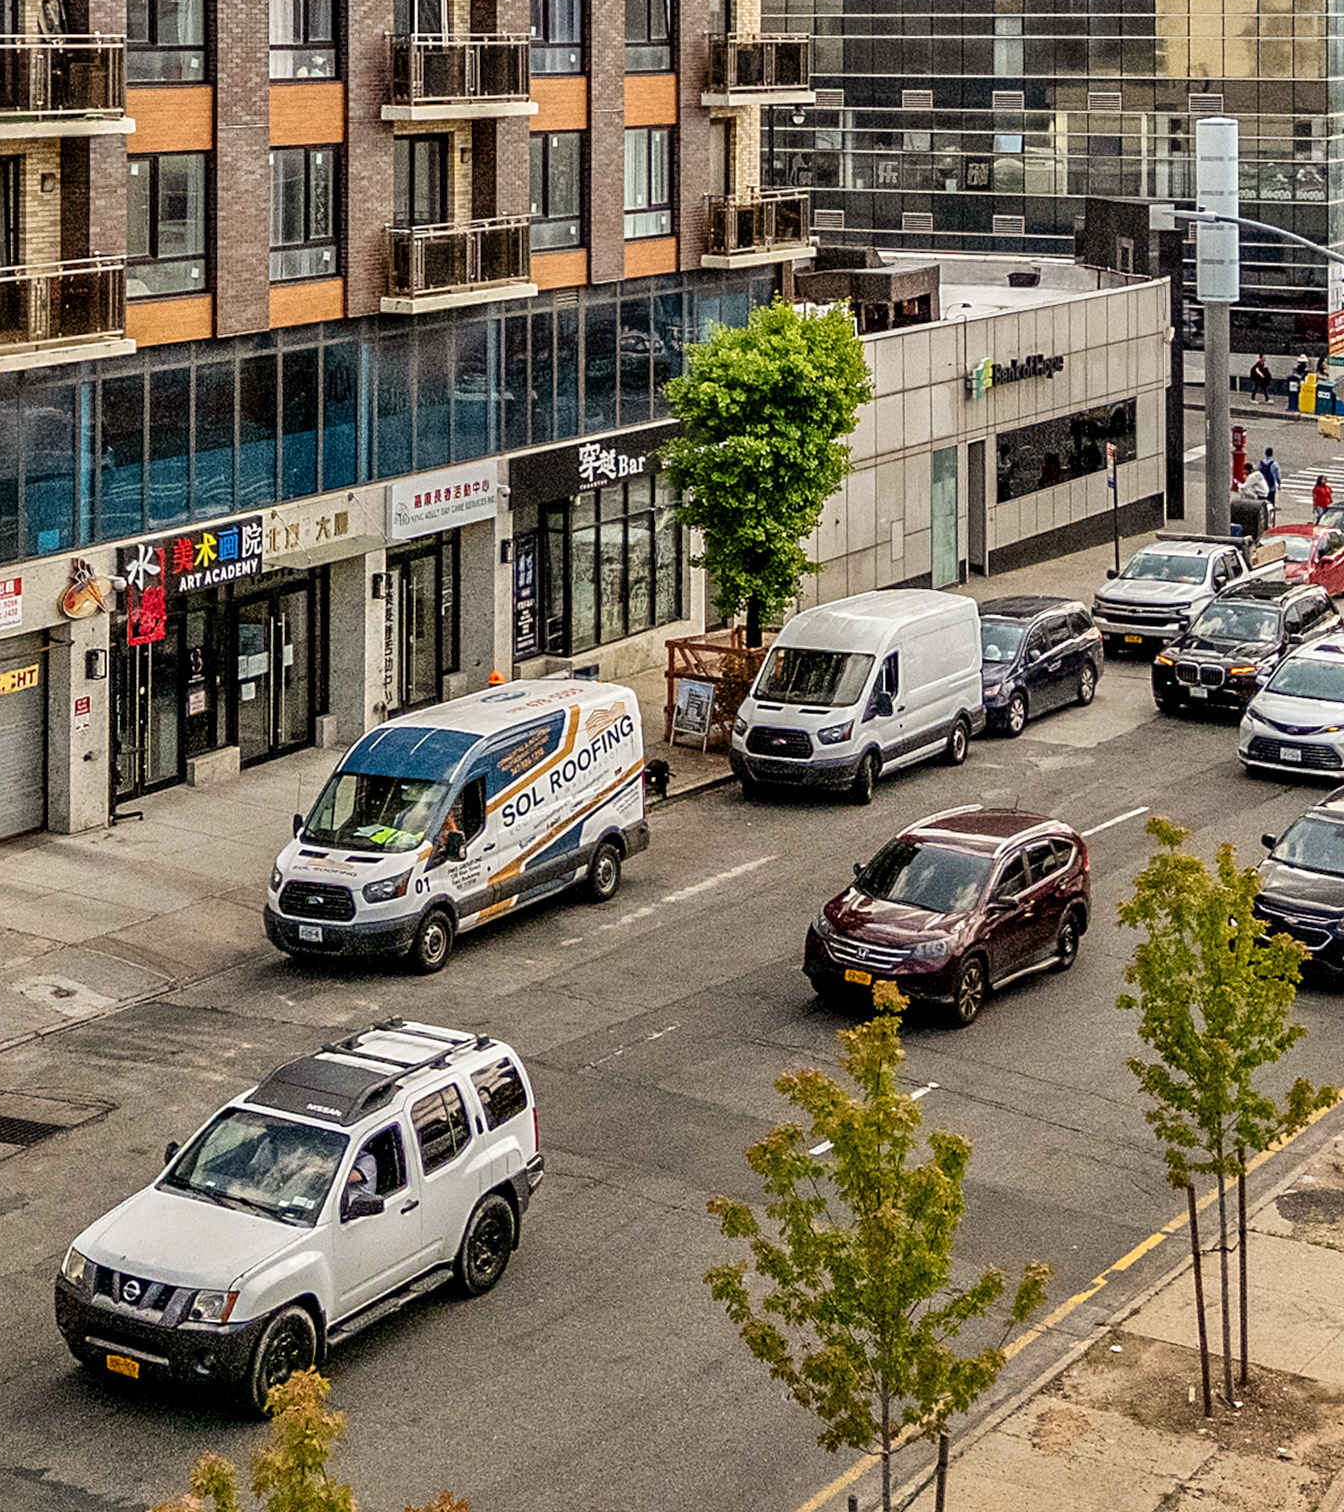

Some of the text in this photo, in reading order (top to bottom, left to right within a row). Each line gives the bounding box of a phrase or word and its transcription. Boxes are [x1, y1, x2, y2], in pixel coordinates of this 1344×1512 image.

[991, 358, 1021, 387] Bank
[1035, 354, 1064, 379] Hope
[617, 454, 646, 478] Bar
[179, 558, 259, 592] ART ACADEMY
[501, 786, 545, 828] SOL
[550, 714, 634, 793] ROOFING
[415, 876, 431, 894] 01
